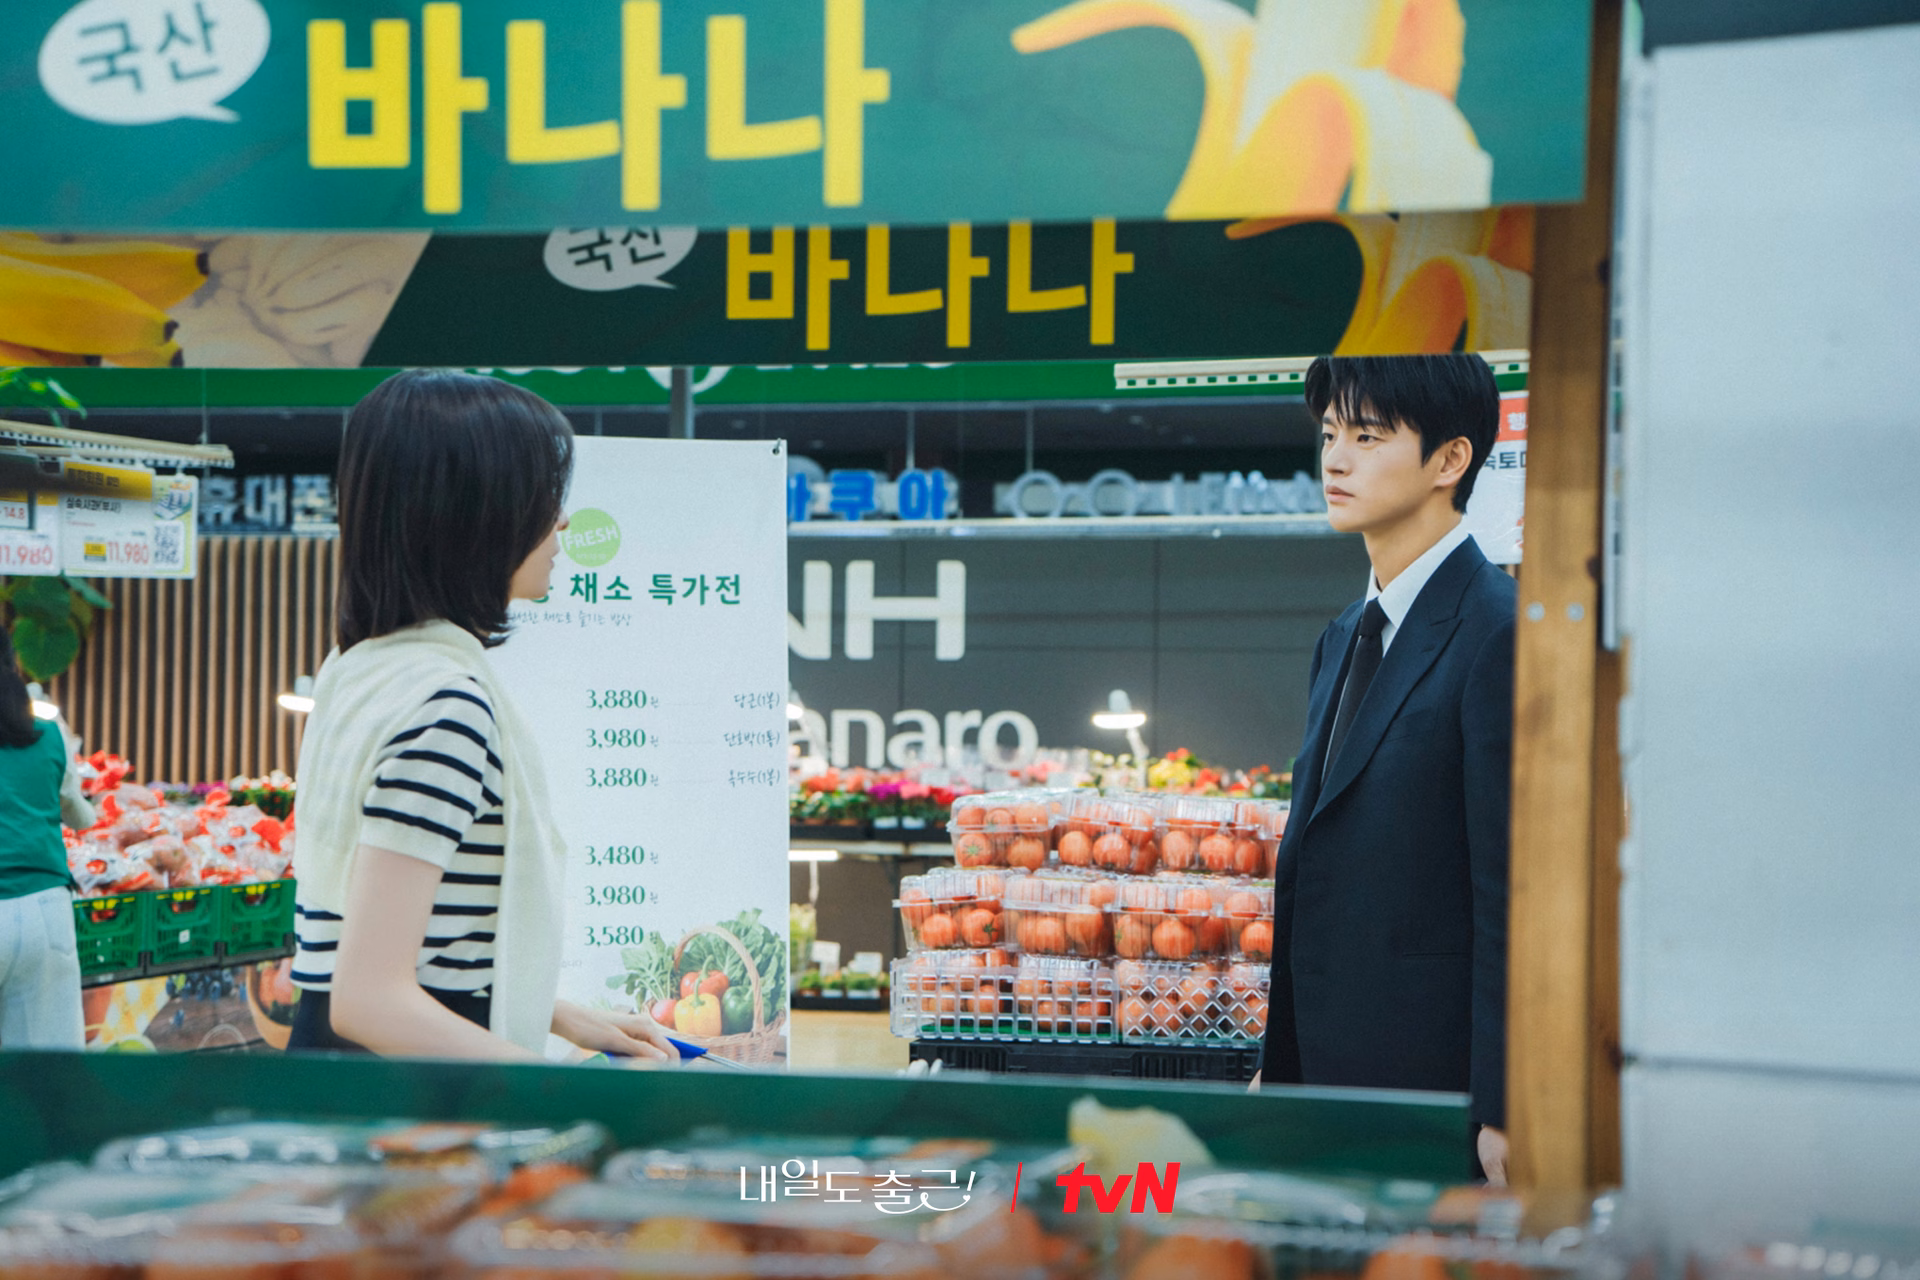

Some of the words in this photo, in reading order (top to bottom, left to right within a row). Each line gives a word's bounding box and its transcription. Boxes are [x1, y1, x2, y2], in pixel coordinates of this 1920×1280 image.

[77, 0, 221, 92] 국산
[307, 0, 890, 214] 바나나
[726, 217, 1135, 351] 바나나
[564, 525, 619, 551] FRESH
[569, 572, 633, 604] 채소
[648, 574, 741, 606] 특가전
